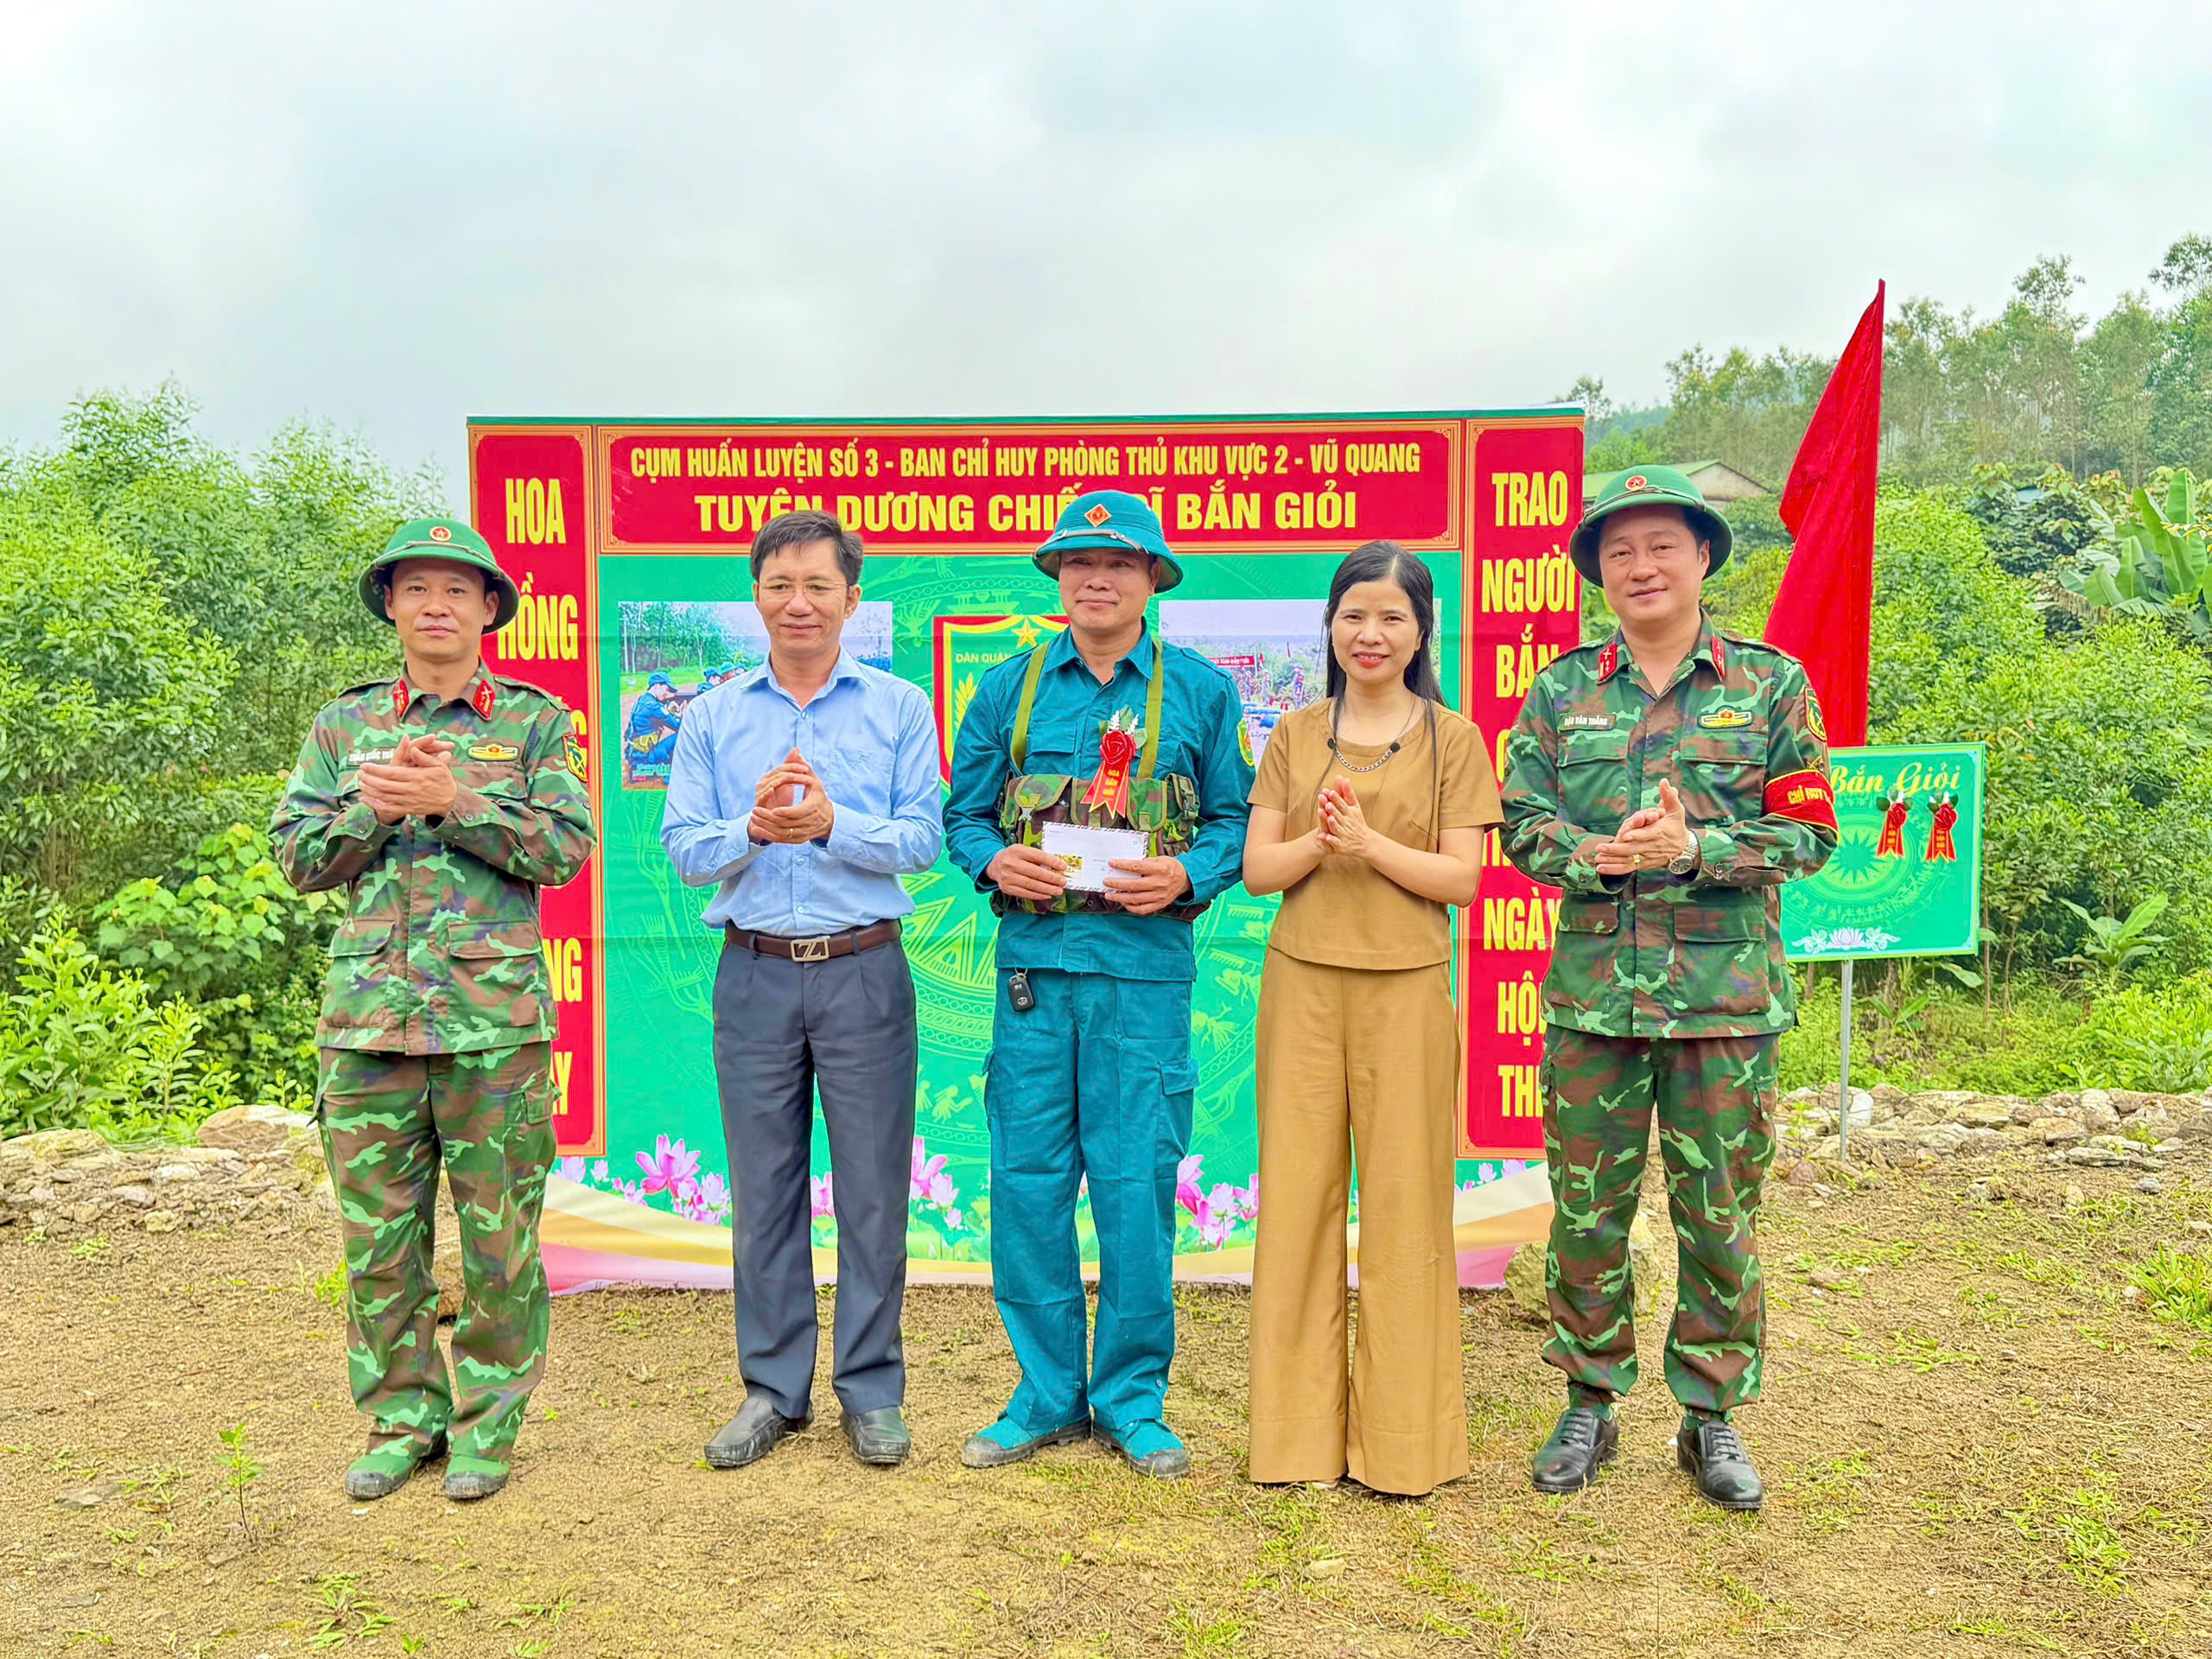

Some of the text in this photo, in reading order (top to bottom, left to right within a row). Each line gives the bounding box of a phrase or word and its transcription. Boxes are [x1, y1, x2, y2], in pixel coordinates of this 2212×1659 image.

[631, 447, 681, 484] CỤM
[687, 437, 747, 477] HUẤN
[754, 442, 823, 484] LUYỆN
[830, 437, 859, 477] SỐ
[865, 448, 879, 477] 3
[900, 447, 945, 477] BAN
[952, 437, 989, 477] CHỈ
[995, 447, 1038, 477] HUY
[1044, 439, 1120, 477] PHÒNG
[1126, 436, 1167, 476] THỦ
[1174, 445, 1218, 475] KHU
[1224, 442, 1268, 481] VỰC
[1274, 445, 1288, 474] 2
[1310, 437, 1338, 474] VŨ
[1345, 442, 1421, 477] QUANG
[505, 477, 567, 545] HOA
[836, 491, 975, 532] DƯƠNG
[1177, 479, 1261, 531] BẮN
[1274, 479, 1357, 529] GIỎI
[1491, 470, 1569, 527] TRAO
[1481, 543, 1575, 613] NGƯỜI
[1830, 761, 1961, 798] Bắn Giỏi
[1484, 887, 1562, 951] NGÀY
